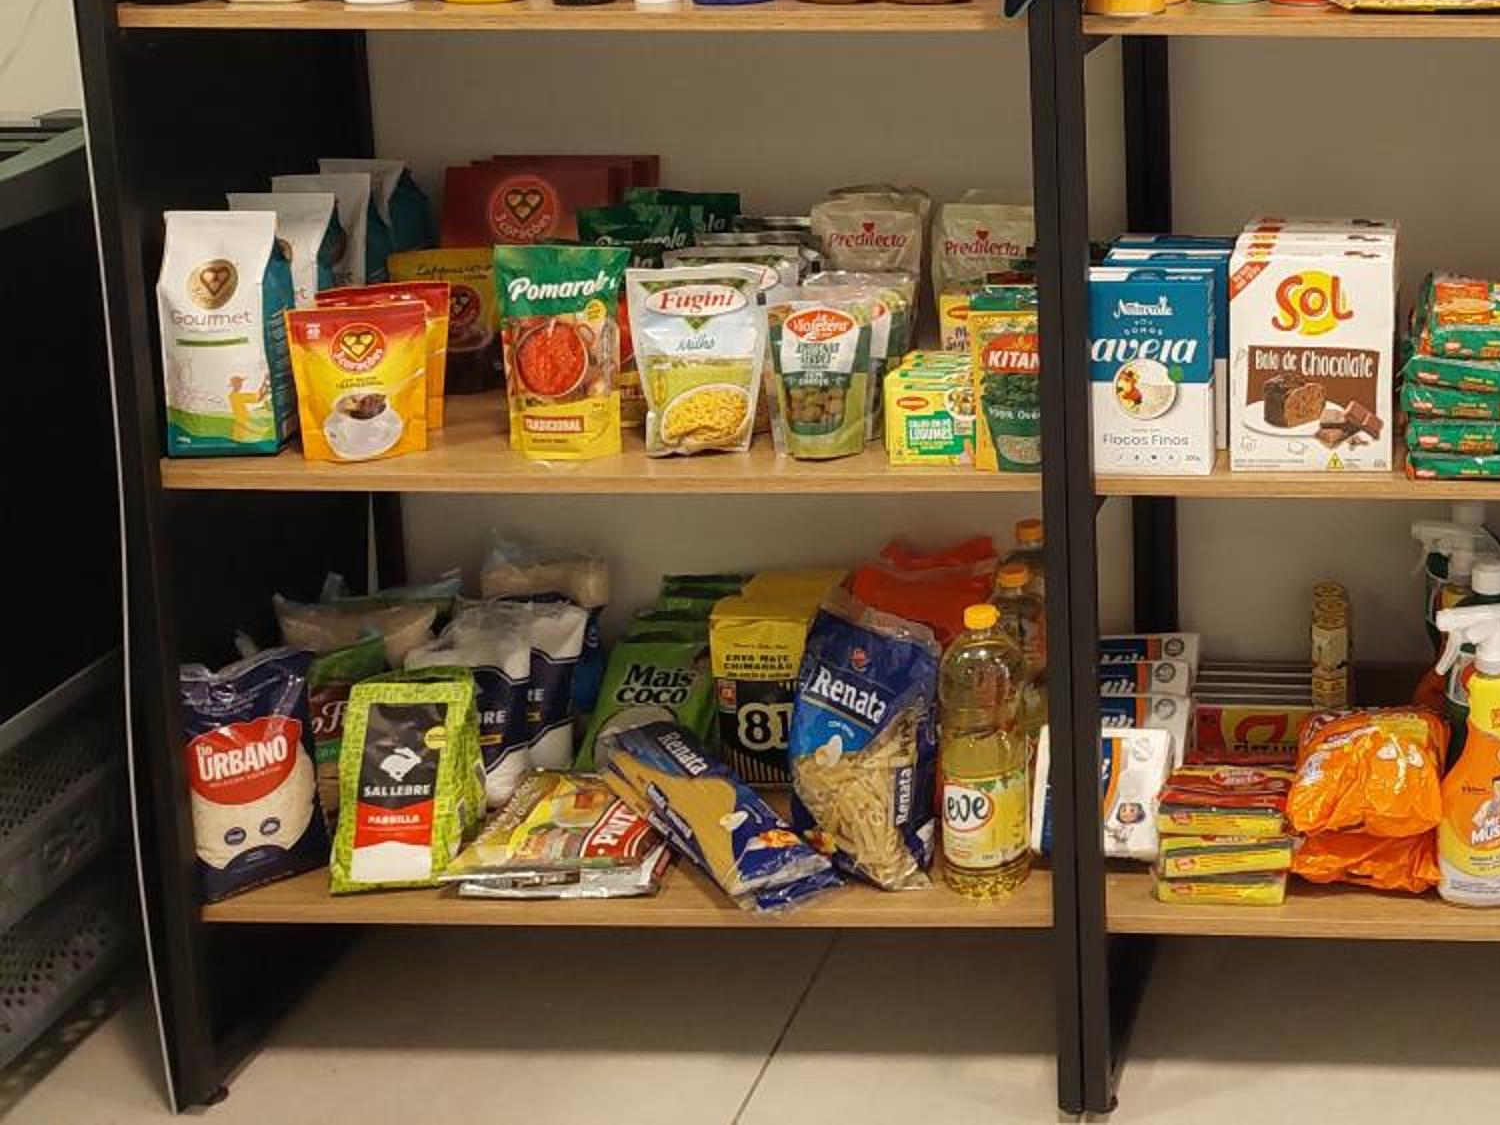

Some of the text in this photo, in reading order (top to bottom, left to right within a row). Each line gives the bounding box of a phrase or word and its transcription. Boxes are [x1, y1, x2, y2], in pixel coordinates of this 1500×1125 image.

[829, 231, 908, 249] Predilecta
[945, 239, 1024, 257] Predilecta
[660, 290, 735, 313] Fugini
[171, 310, 253, 326] Gourmet
[988, 350, 1040, 368] KITAN
[1090, 337, 1198, 363] aveia
[1255, 348, 1375, 379] Bolo de Chocolate
[1103, 433, 1189, 446] Flocos Finos
[626, 663, 692, 687] Mais
[616, 686, 689, 705] coco
[810, 665, 888, 725] Renata
[197, 734, 289, 783] URBANO
[657, 730, 709, 776] Renata
